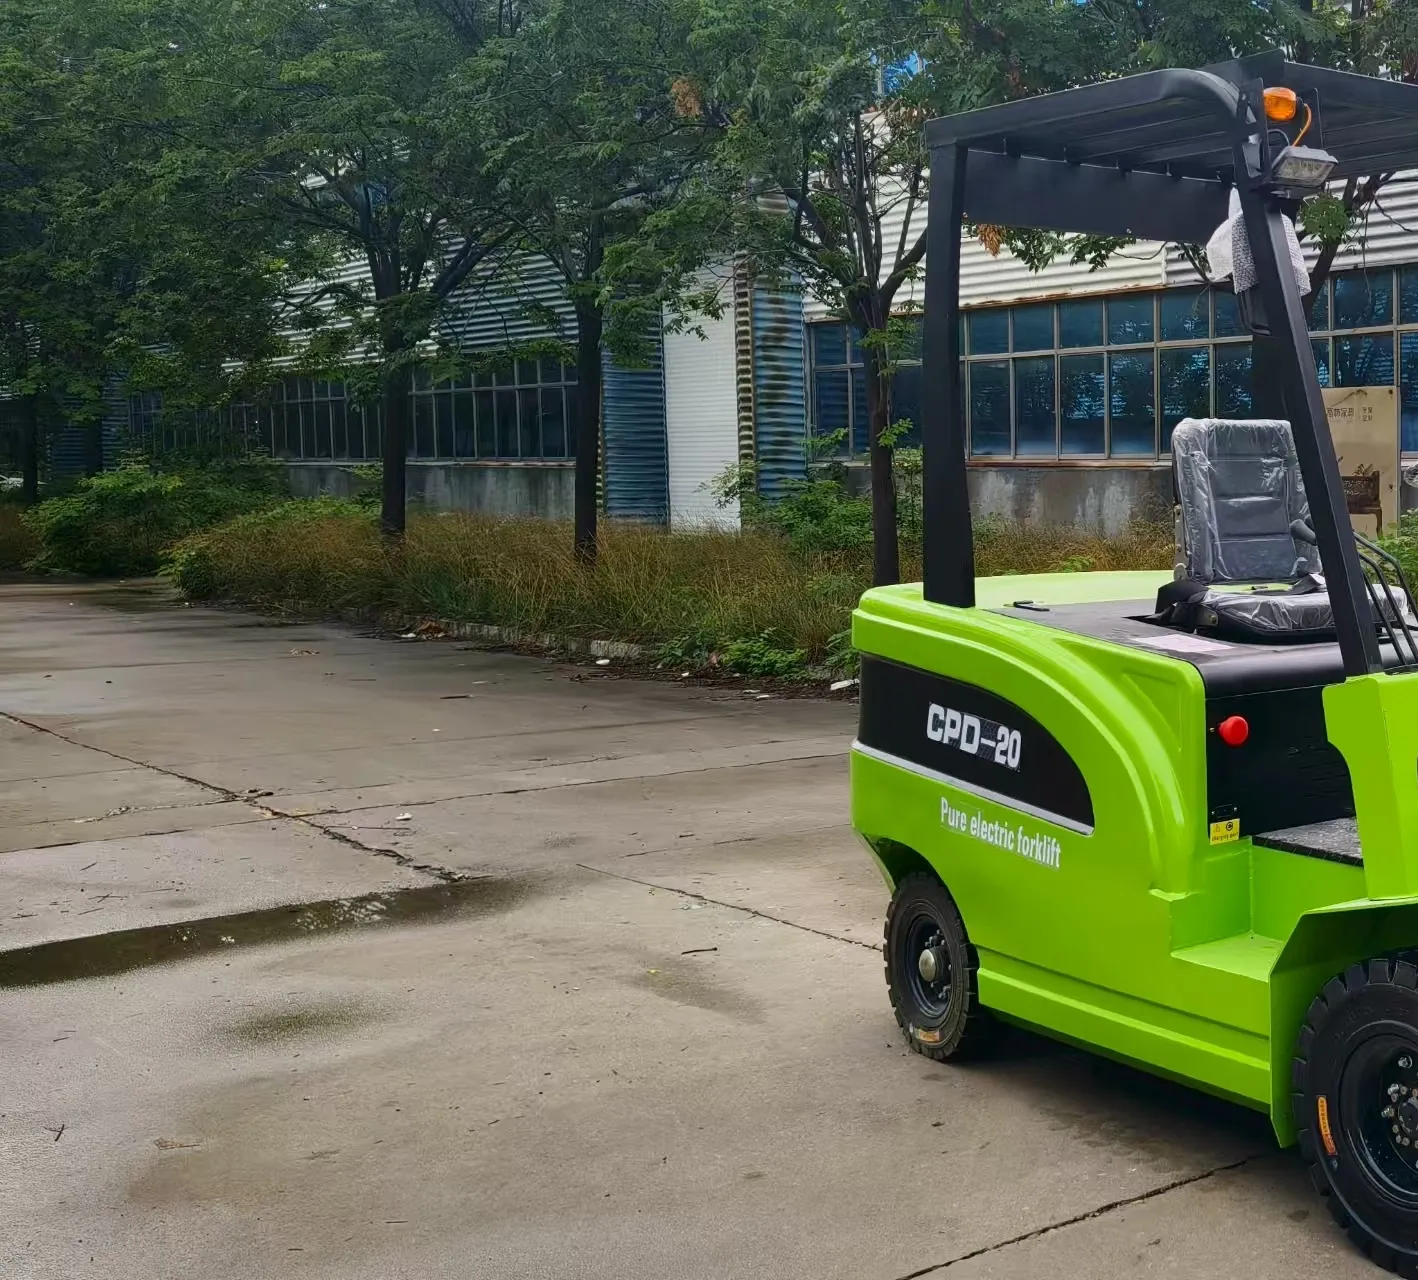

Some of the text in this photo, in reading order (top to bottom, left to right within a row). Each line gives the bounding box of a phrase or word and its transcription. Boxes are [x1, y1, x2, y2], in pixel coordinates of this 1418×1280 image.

[927, 703, 1022, 768] CPD-20
[940, 797, 1061, 868] Pure electric forklift
